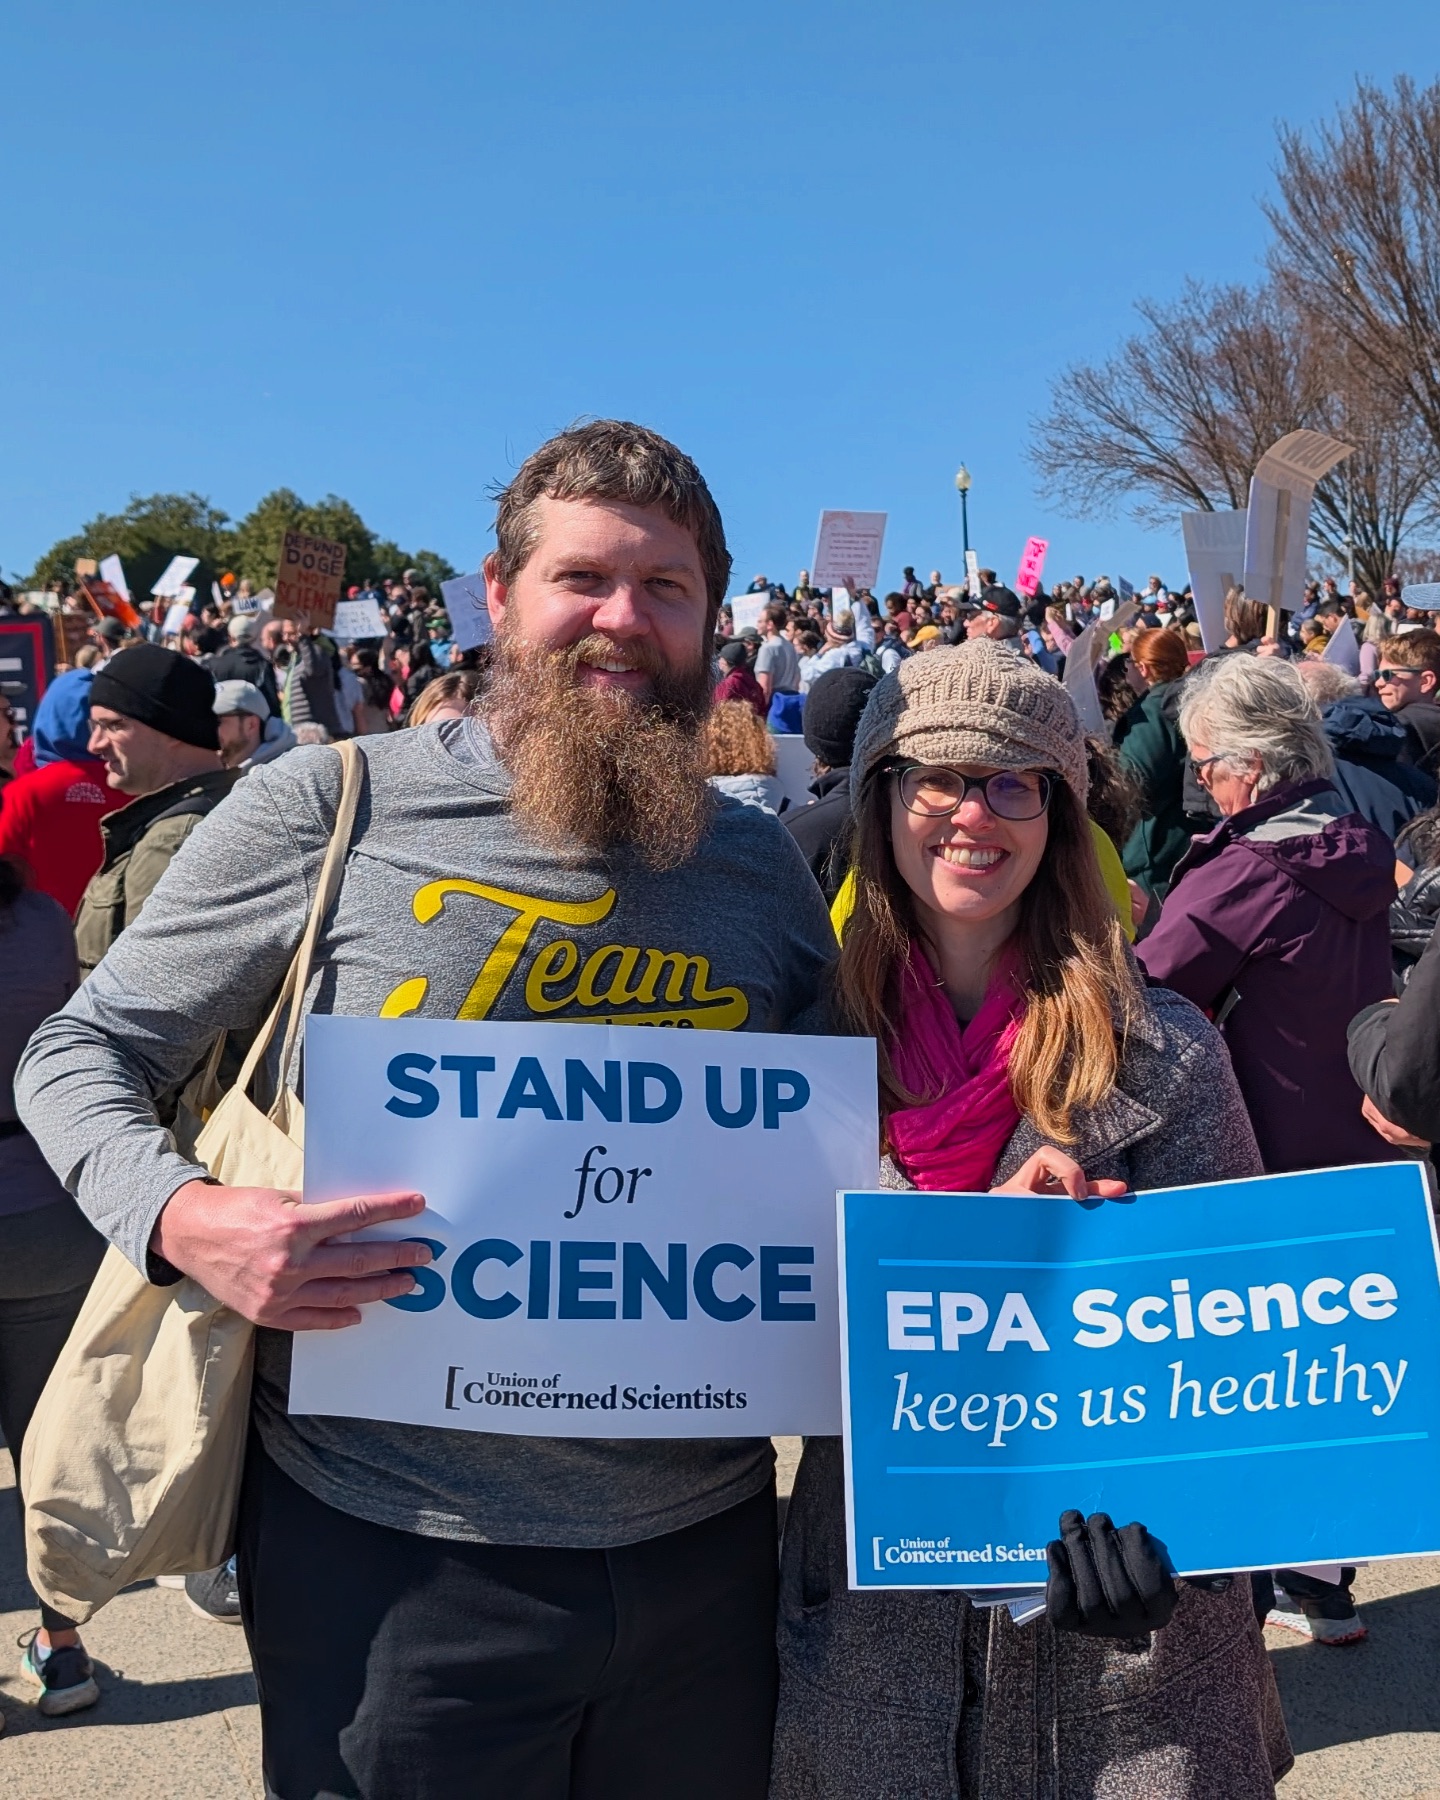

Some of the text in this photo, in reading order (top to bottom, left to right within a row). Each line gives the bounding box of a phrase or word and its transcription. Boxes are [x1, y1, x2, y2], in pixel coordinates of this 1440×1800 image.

[285, 533, 343, 558] DEFUND
[287, 549, 341, 576] DOGE
[298, 569, 328, 591] NOT
[379, 878, 748, 1021] Team
[384, 1053, 810, 1130] STAND UP
[563, 1145, 652, 1219] for
[381, 1237, 816, 1322] SCIENCE
[886, 1272, 1398, 1352] EPA Science
[487, 1372, 562, 1388] Union of
[463, 1382, 748, 1410] Concerned Scientists
[892, 1343, 1409, 1448] keeps us healthy
[885, 1542, 1047, 1564] Concerned Scien
[899, 1537, 951, 1550] Union of
